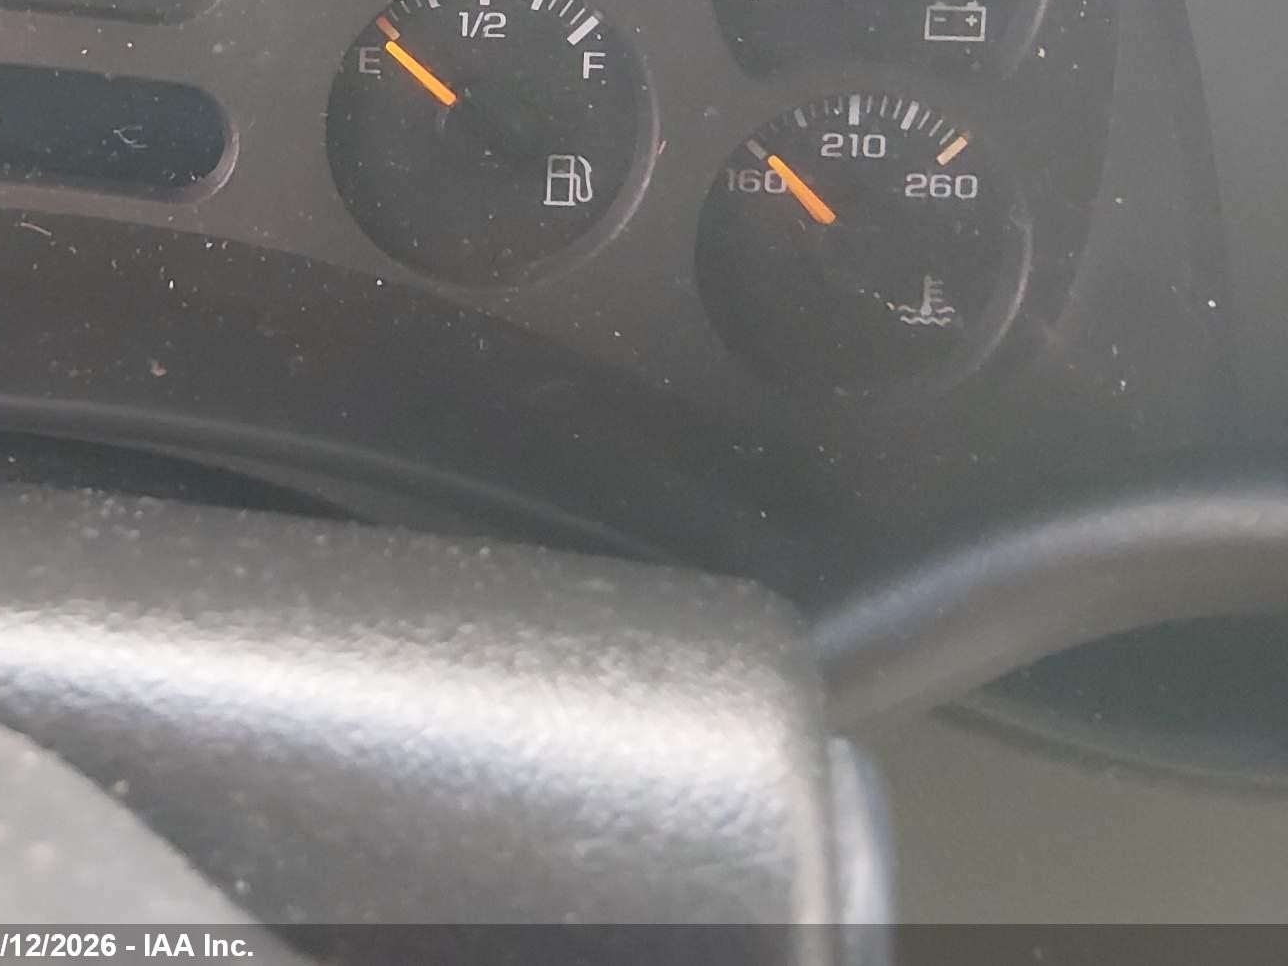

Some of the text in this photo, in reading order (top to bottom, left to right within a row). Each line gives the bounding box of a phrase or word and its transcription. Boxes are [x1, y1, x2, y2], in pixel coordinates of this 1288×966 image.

[459, 12, 507, 38] 1/2
[359, 47, 380, 74] E
[583, 52, 606, 79] F
[821, 133, 886, 158] 210
[729, 170, 788, 194] 160
[905, 173, 978, 199] 260
